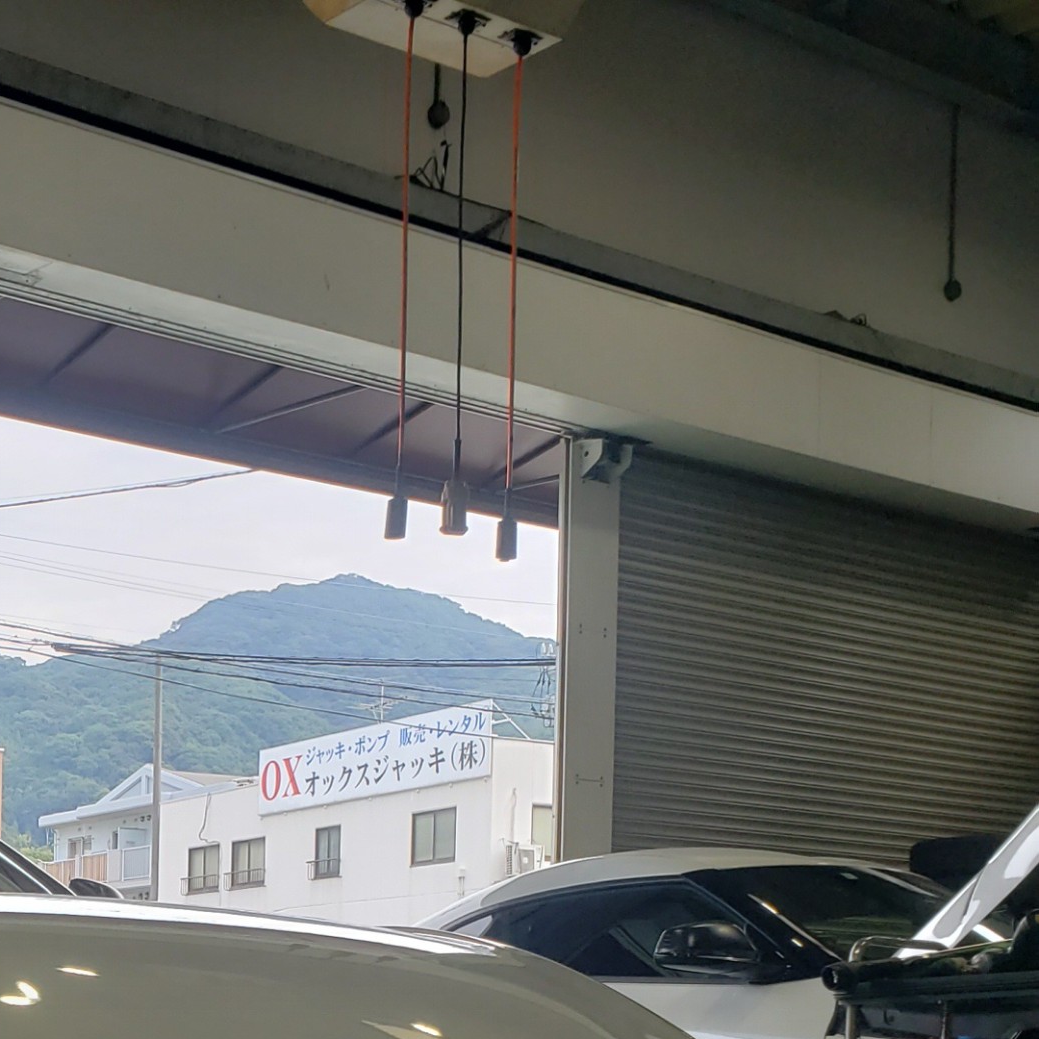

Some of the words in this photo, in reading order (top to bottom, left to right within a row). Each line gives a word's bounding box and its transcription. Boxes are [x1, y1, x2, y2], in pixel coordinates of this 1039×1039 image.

[398, 714, 487, 748] 販売・レンタル
[261, 754, 303, 801] OX
